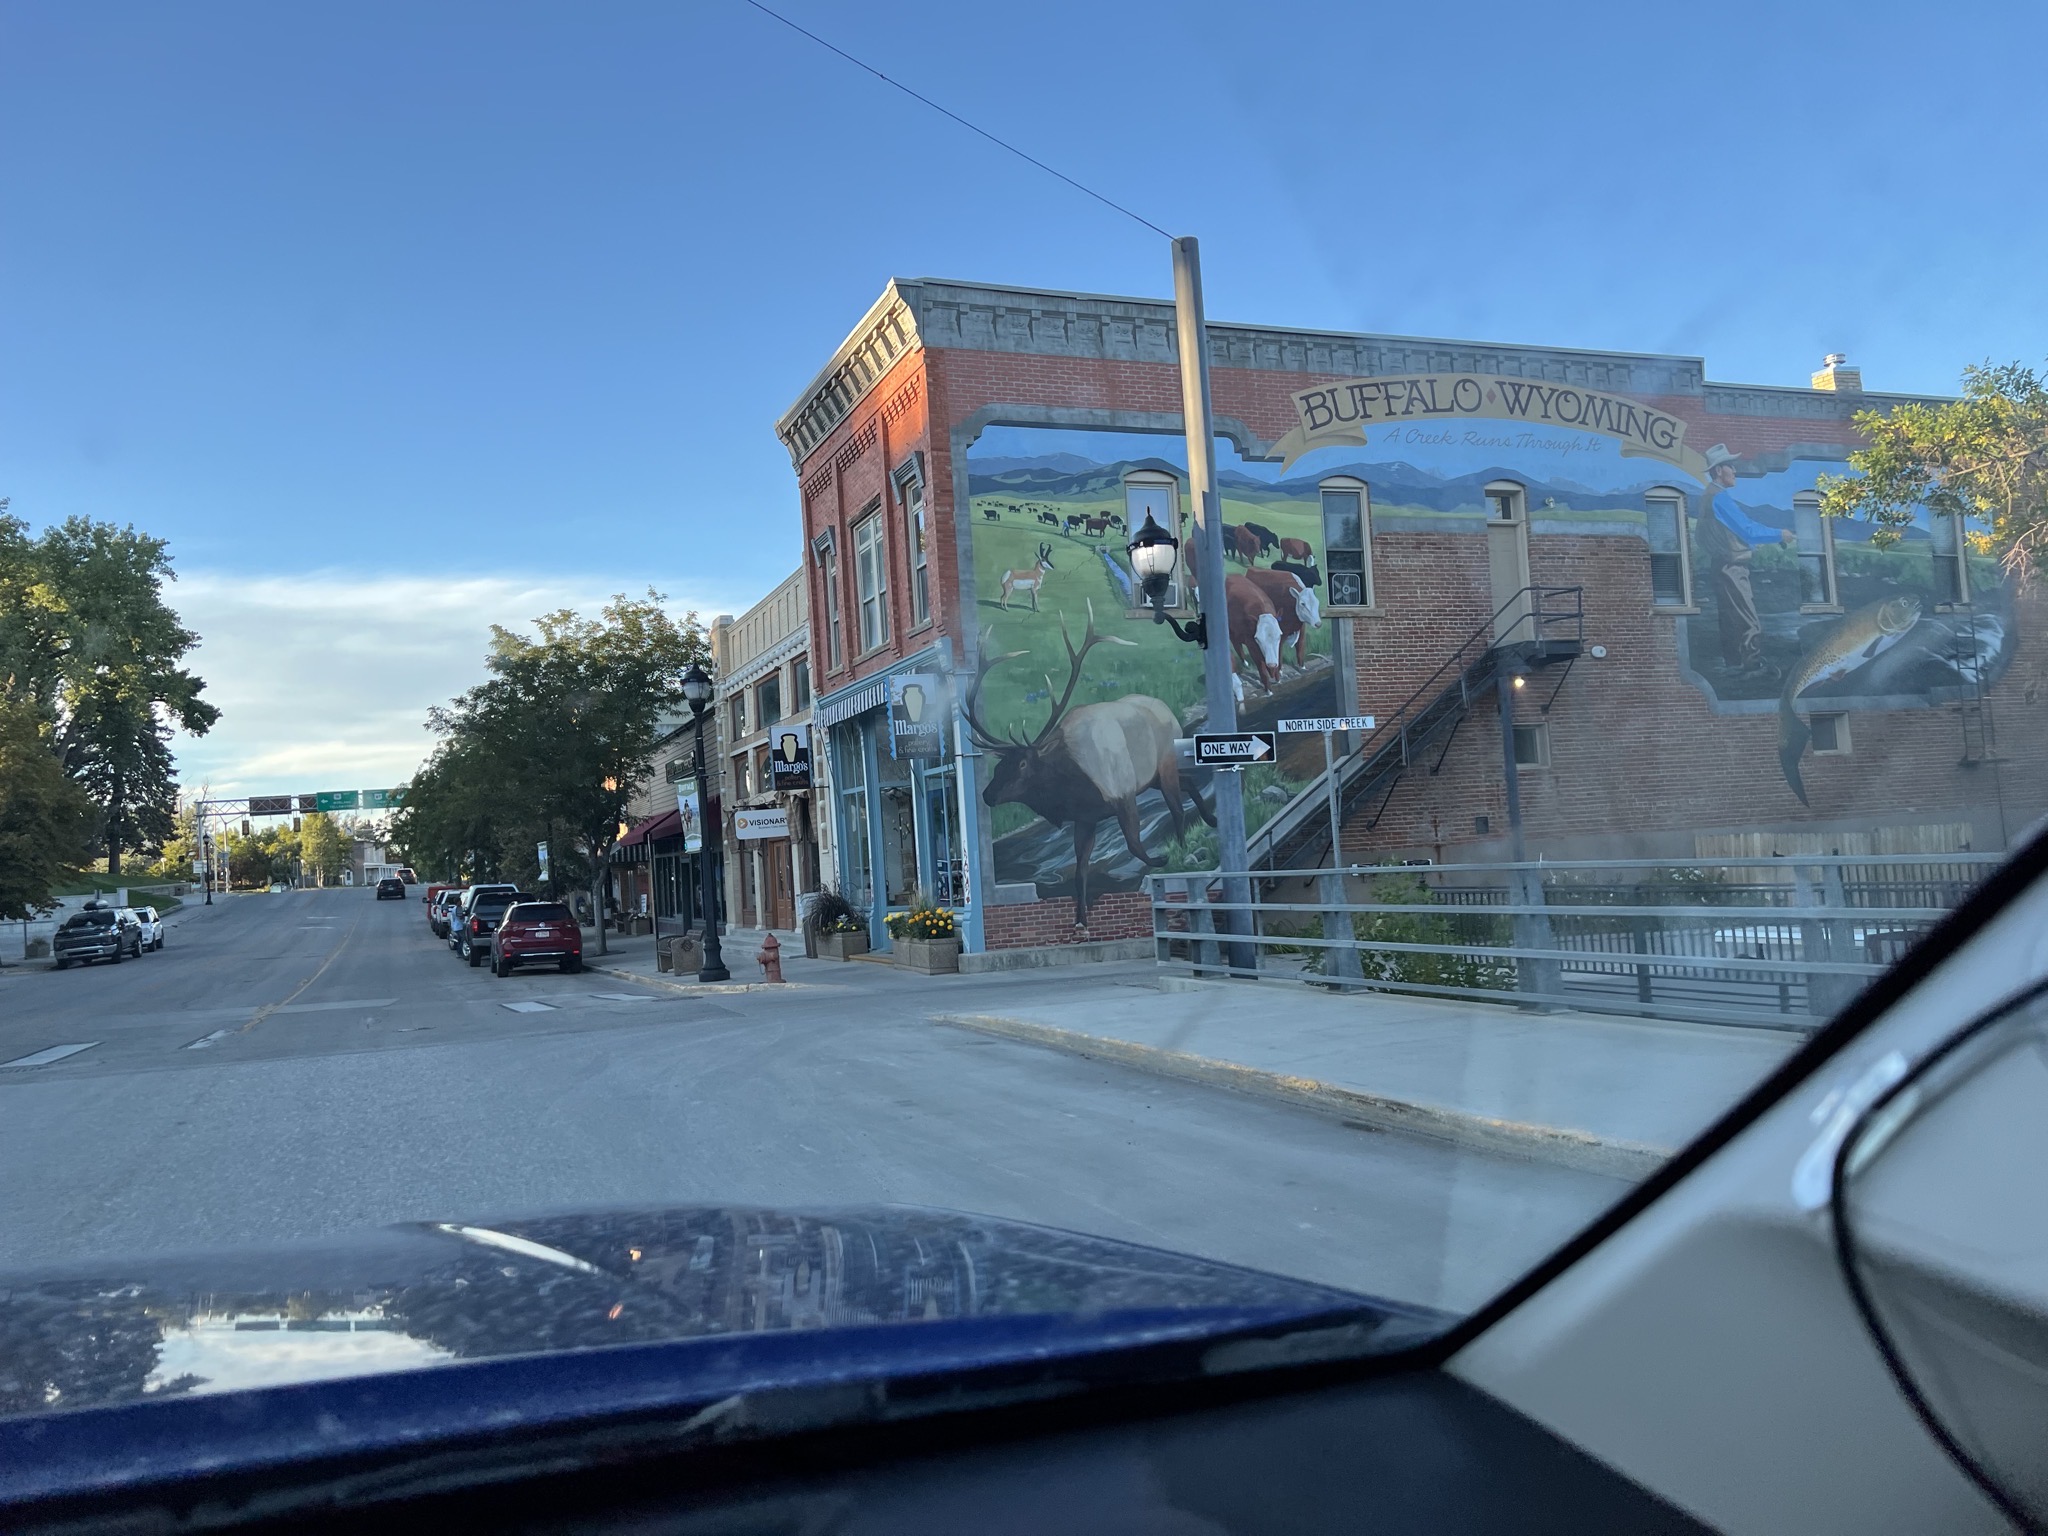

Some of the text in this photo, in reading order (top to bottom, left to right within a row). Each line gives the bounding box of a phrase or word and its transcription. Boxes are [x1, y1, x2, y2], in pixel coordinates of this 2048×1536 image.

[1299, 378, 1679, 450] BUFFALO WYOMING
[1383, 428, 1602, 457] A Creek Runs Through It
[894, 719, 938, 737] Margo's
[1285, 717, 1367, 731] NORTH SIDE CREEK
[1204, 742, 1251, 755] ONE WAY
[774, 760, 809, 775] Margo's
